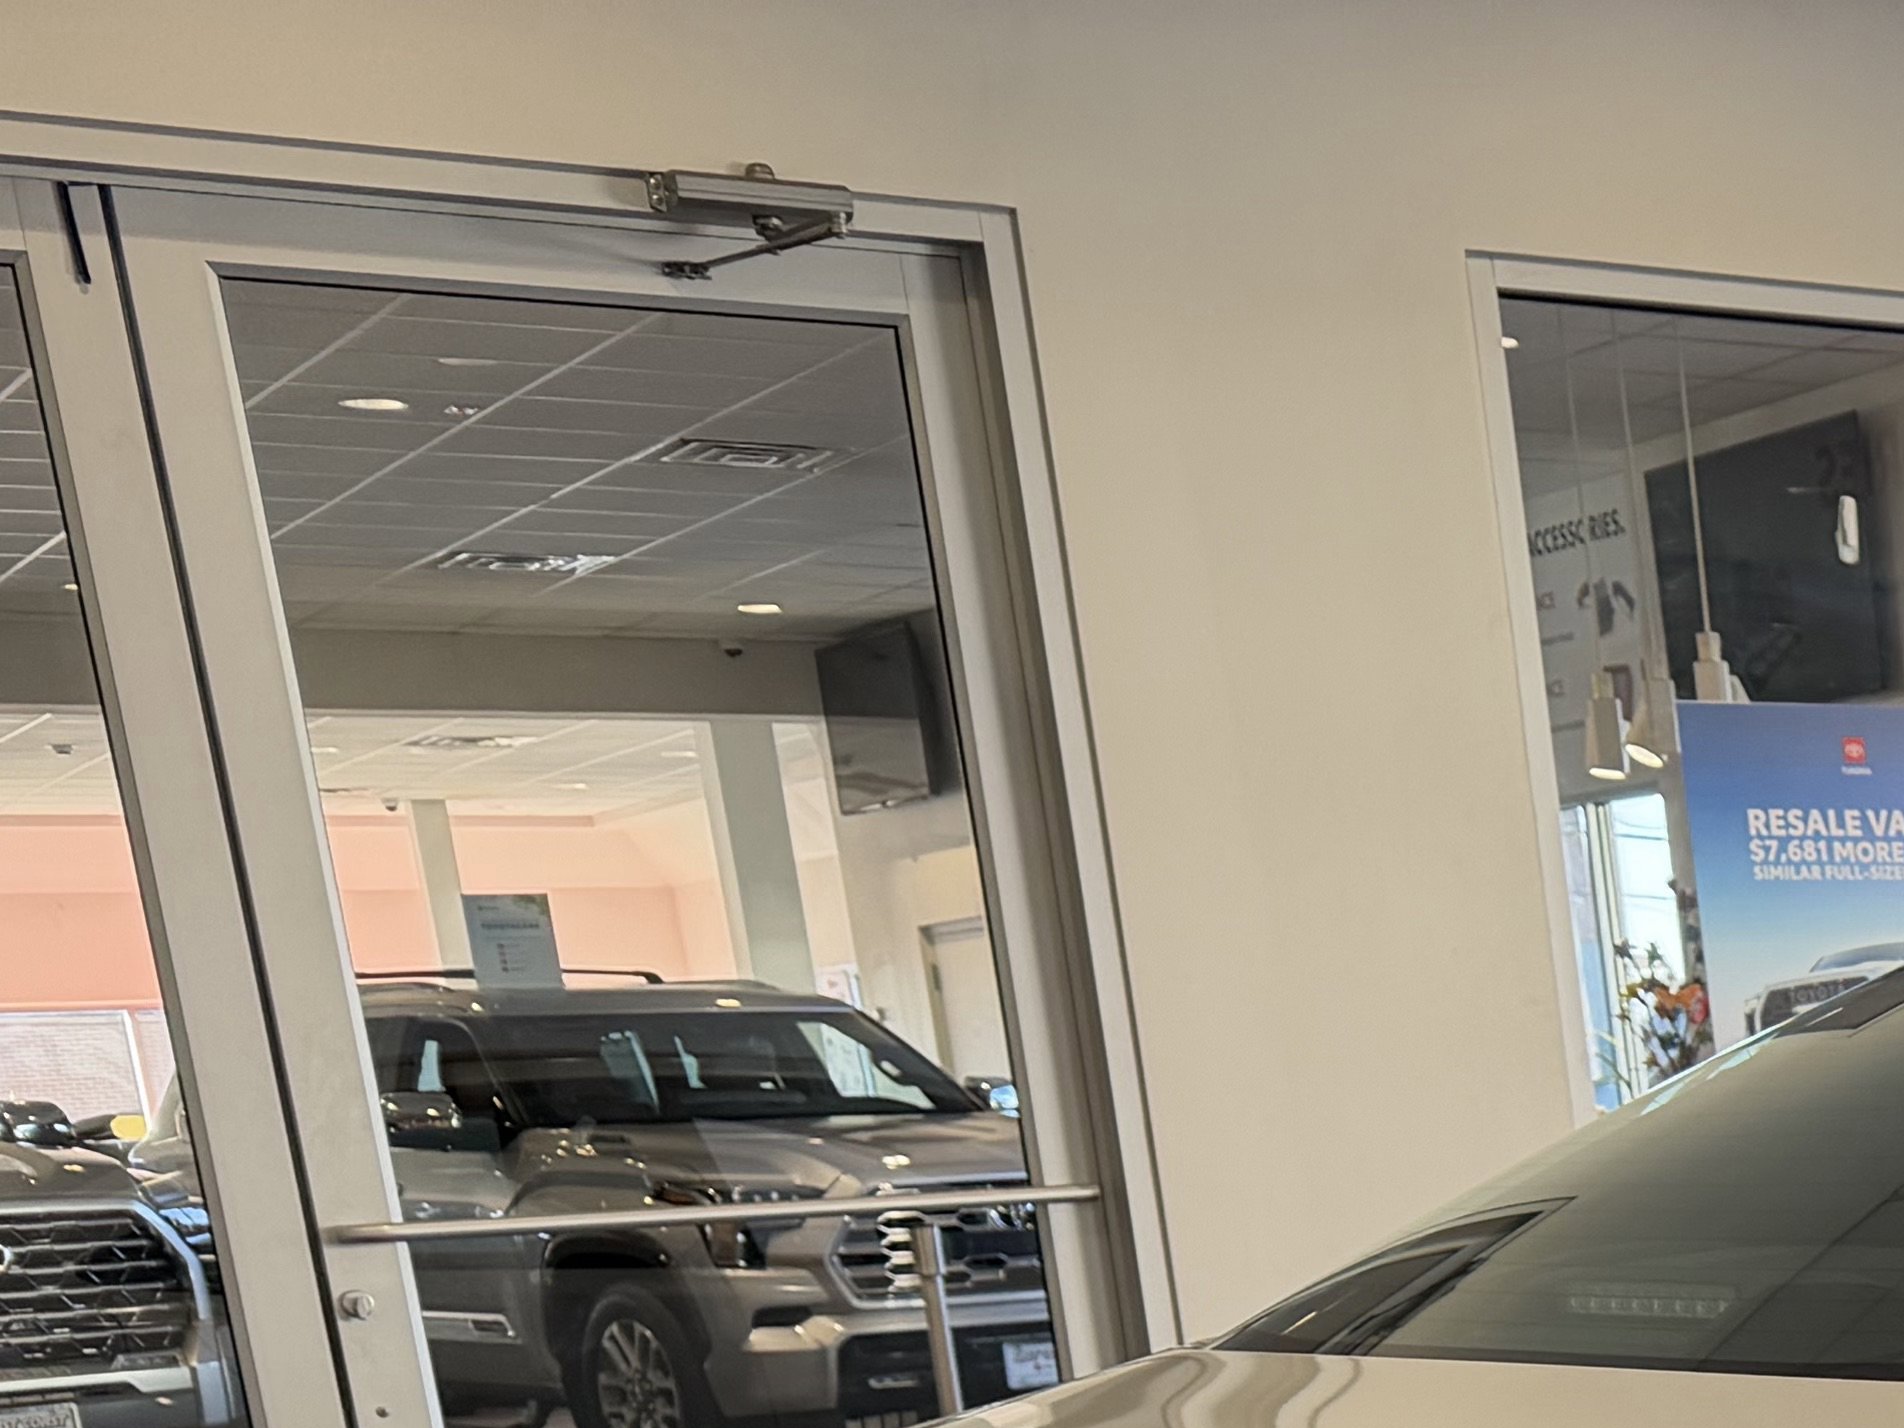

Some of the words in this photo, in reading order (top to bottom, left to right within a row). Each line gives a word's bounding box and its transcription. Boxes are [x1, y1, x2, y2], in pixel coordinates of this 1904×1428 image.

[1747, 808, 1862, 838] RESALE
[1749, 839, 1829, 866] $7,681
[1754, 865, 1822, 881] SIMILAR
